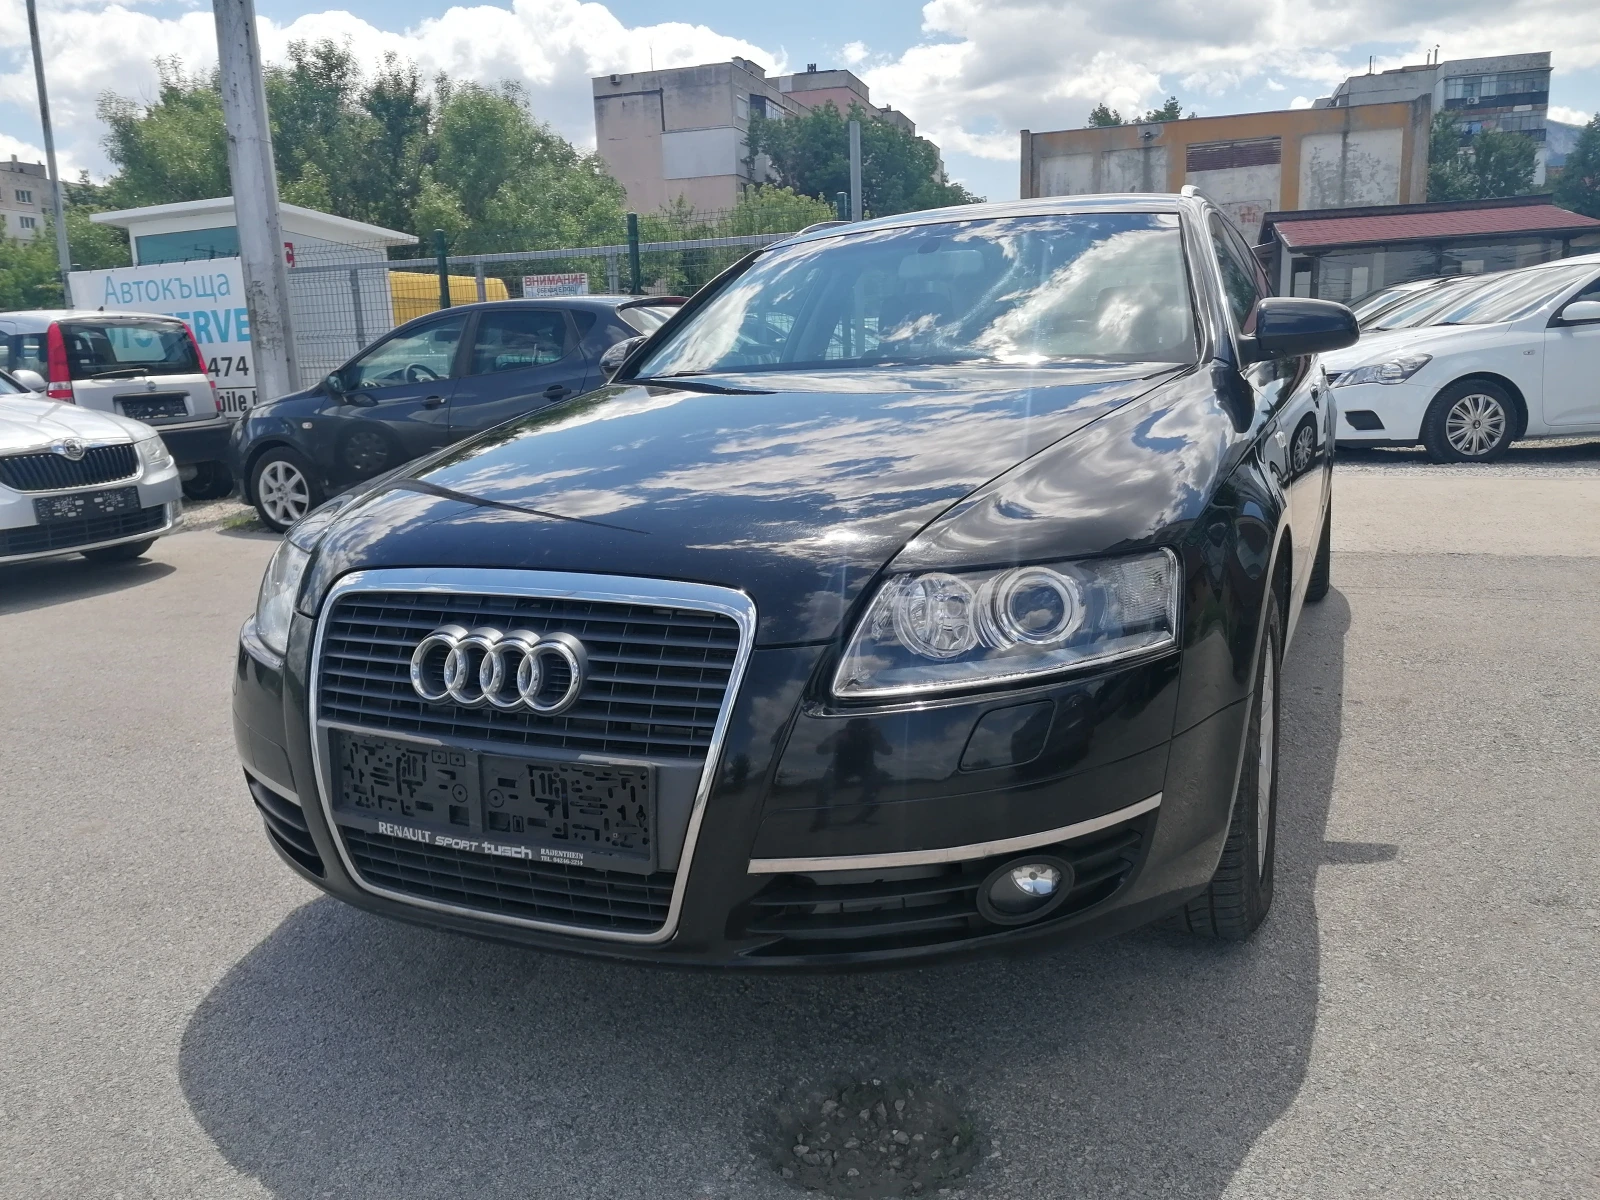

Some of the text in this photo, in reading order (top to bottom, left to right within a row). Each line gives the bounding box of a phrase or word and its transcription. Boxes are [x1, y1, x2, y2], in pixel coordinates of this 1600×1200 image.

[104, 273, 231, 305] Автокъща
[525, 274, 586, 287] ВНИМАНИЕ
[378, 821, 532, 860] RENAULT SPORT tusch
[540, 848, 583, 860] RADENTHEIN
